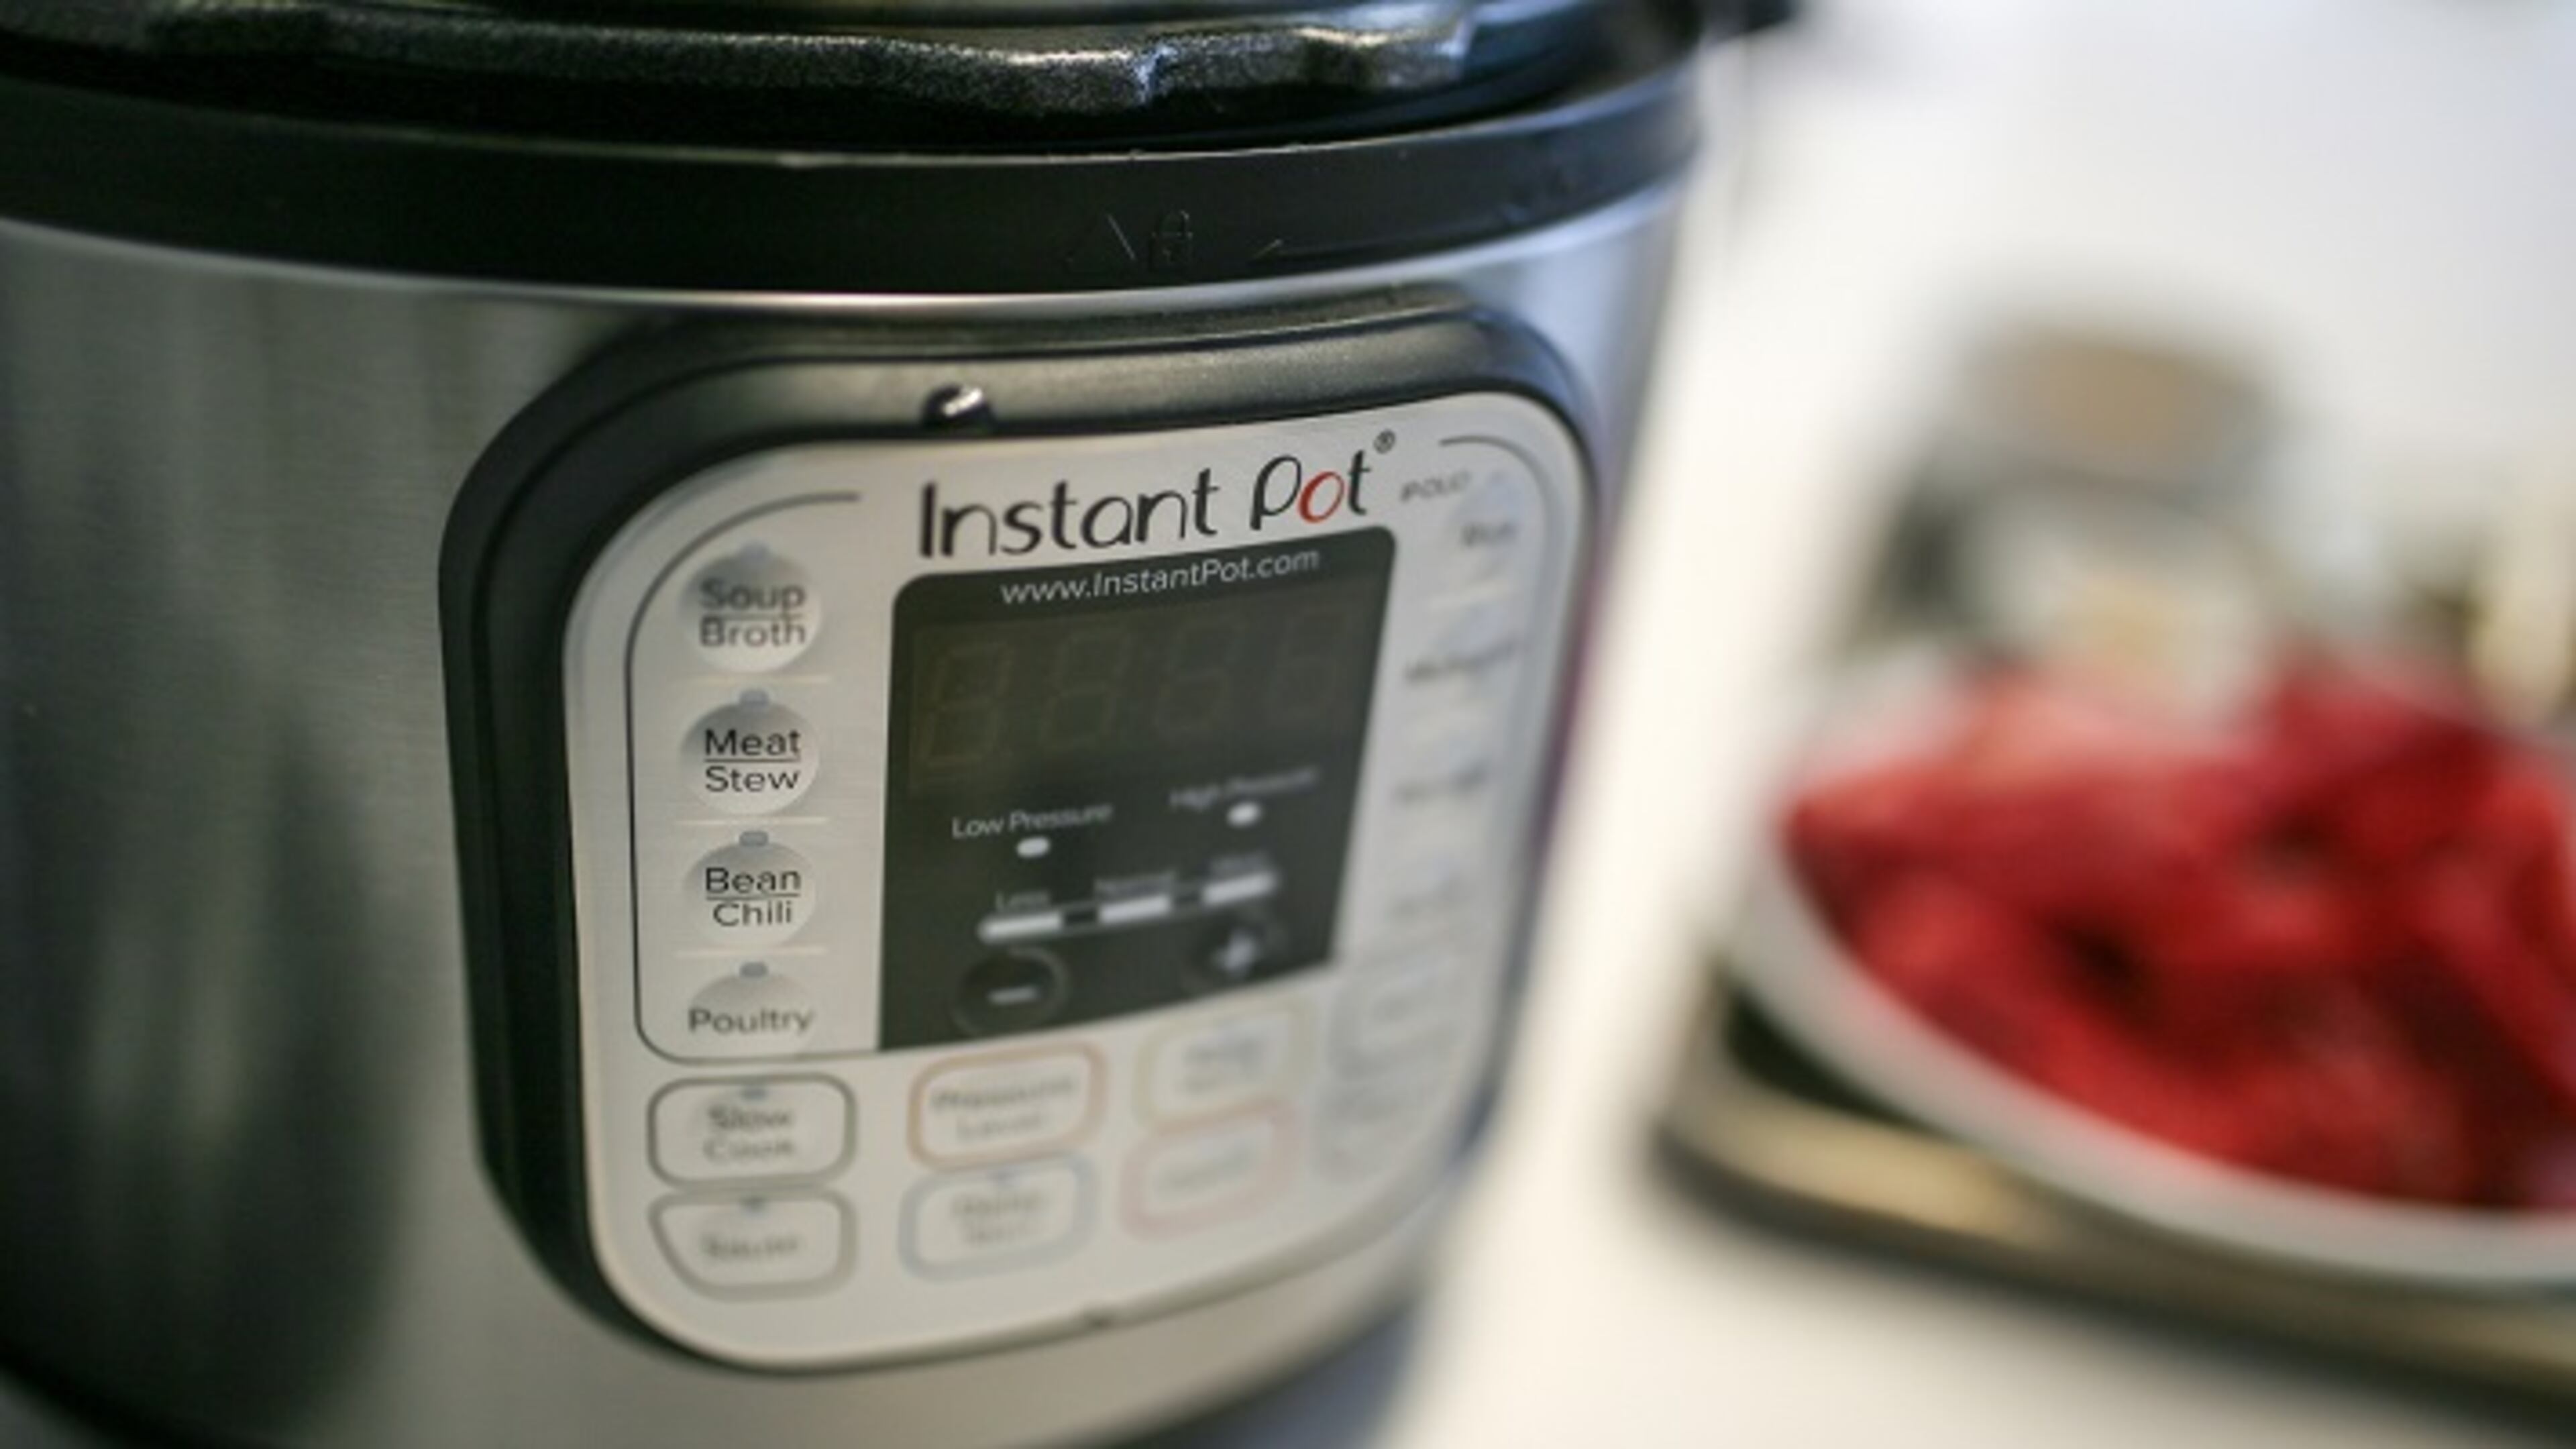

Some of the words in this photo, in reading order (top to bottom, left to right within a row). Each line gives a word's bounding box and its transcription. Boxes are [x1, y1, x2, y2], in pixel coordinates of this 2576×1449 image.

[917, 468, 1218, 559] Instant
[1000, 546, 1320, 605] www.InstantPot.com
[699, 577, 807, 617] Soup
[699, 615, 806, 647] Broth
[704, 729, 801, 756] Meat
[704, 765, 801, 793] Stew
[951, 816, 1004, 839] Low
[1009, 803, 1114, 833] Pressure
[704, 867, 802, 894] Bean
[712, 900, 793, 928] Chili
[687, 1006, 814, 1037] Poultry
